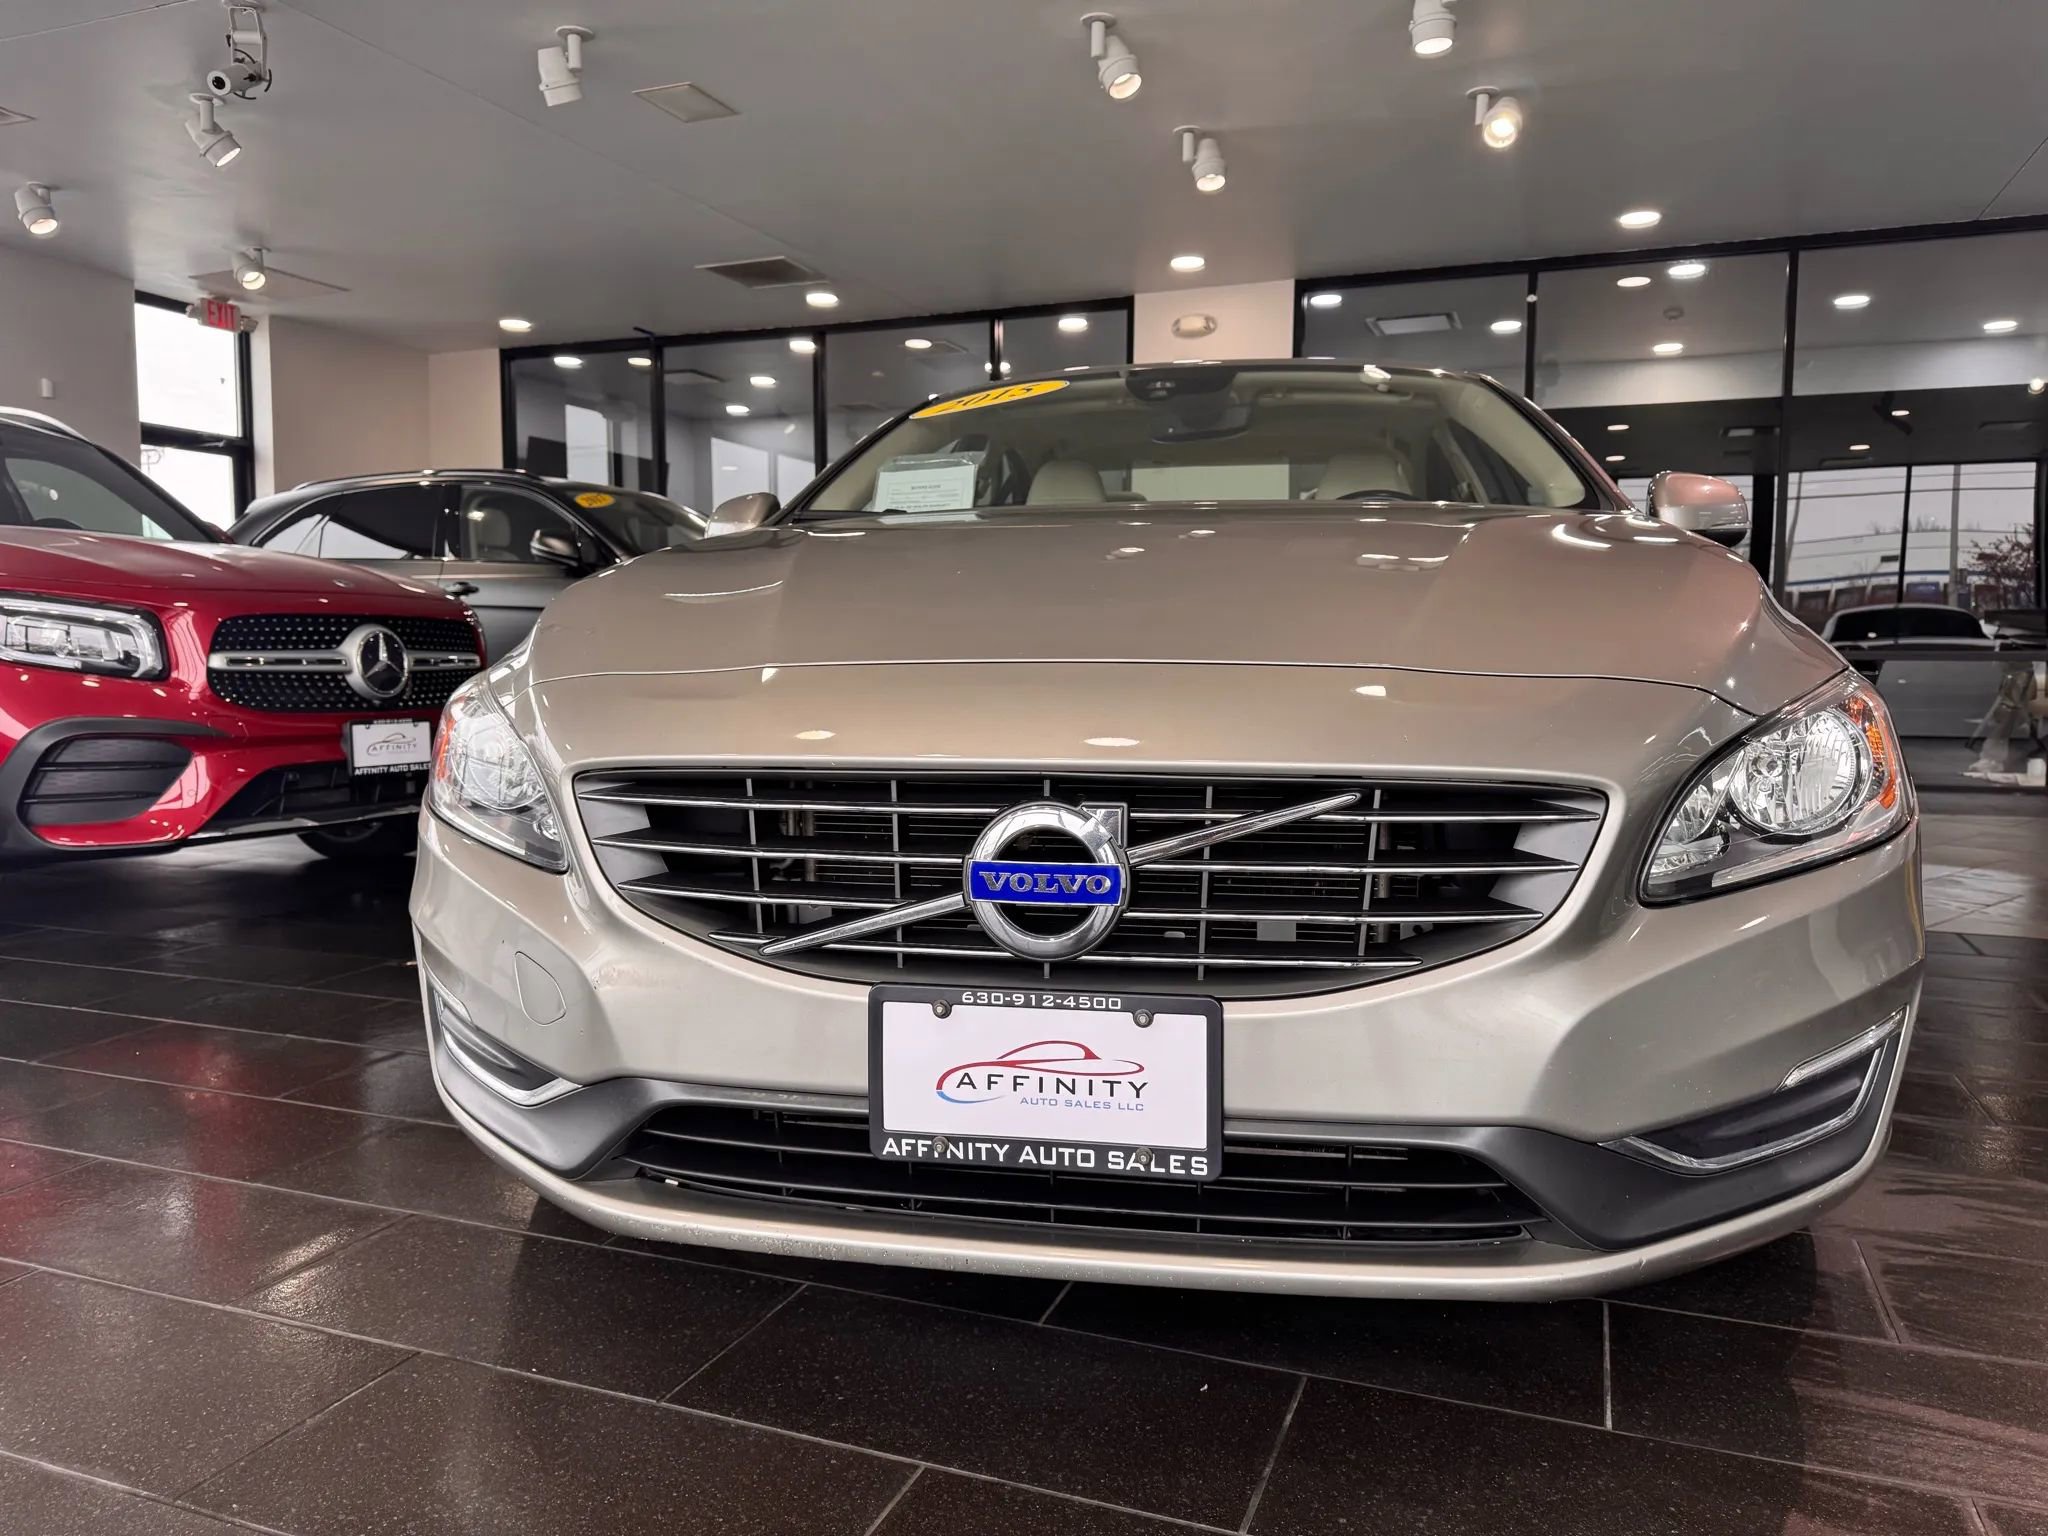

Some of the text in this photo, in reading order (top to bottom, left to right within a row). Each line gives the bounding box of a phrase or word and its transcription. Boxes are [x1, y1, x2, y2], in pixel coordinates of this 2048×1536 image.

[207, 300, 236, 332] EXIT
[937, 383, 1041, 413] 2015
[372, 743, 417, 751] AFFINITY
[354, 767, 388, 776] AFFINITY
[390, 765, 408, 773] AUTO
[979, 871, 1111, 895] VOLVO
[961, 991, 1121, 1010] 630-912-4500
[956, 1072, 1148, 1099] AFFINITY
[1020, 1096, 1144, 1112] AUTO SALES LLC
[1018, 1145, 1095, 1168] AUTO
[1108, 1151, 1208, 1176] SALES
